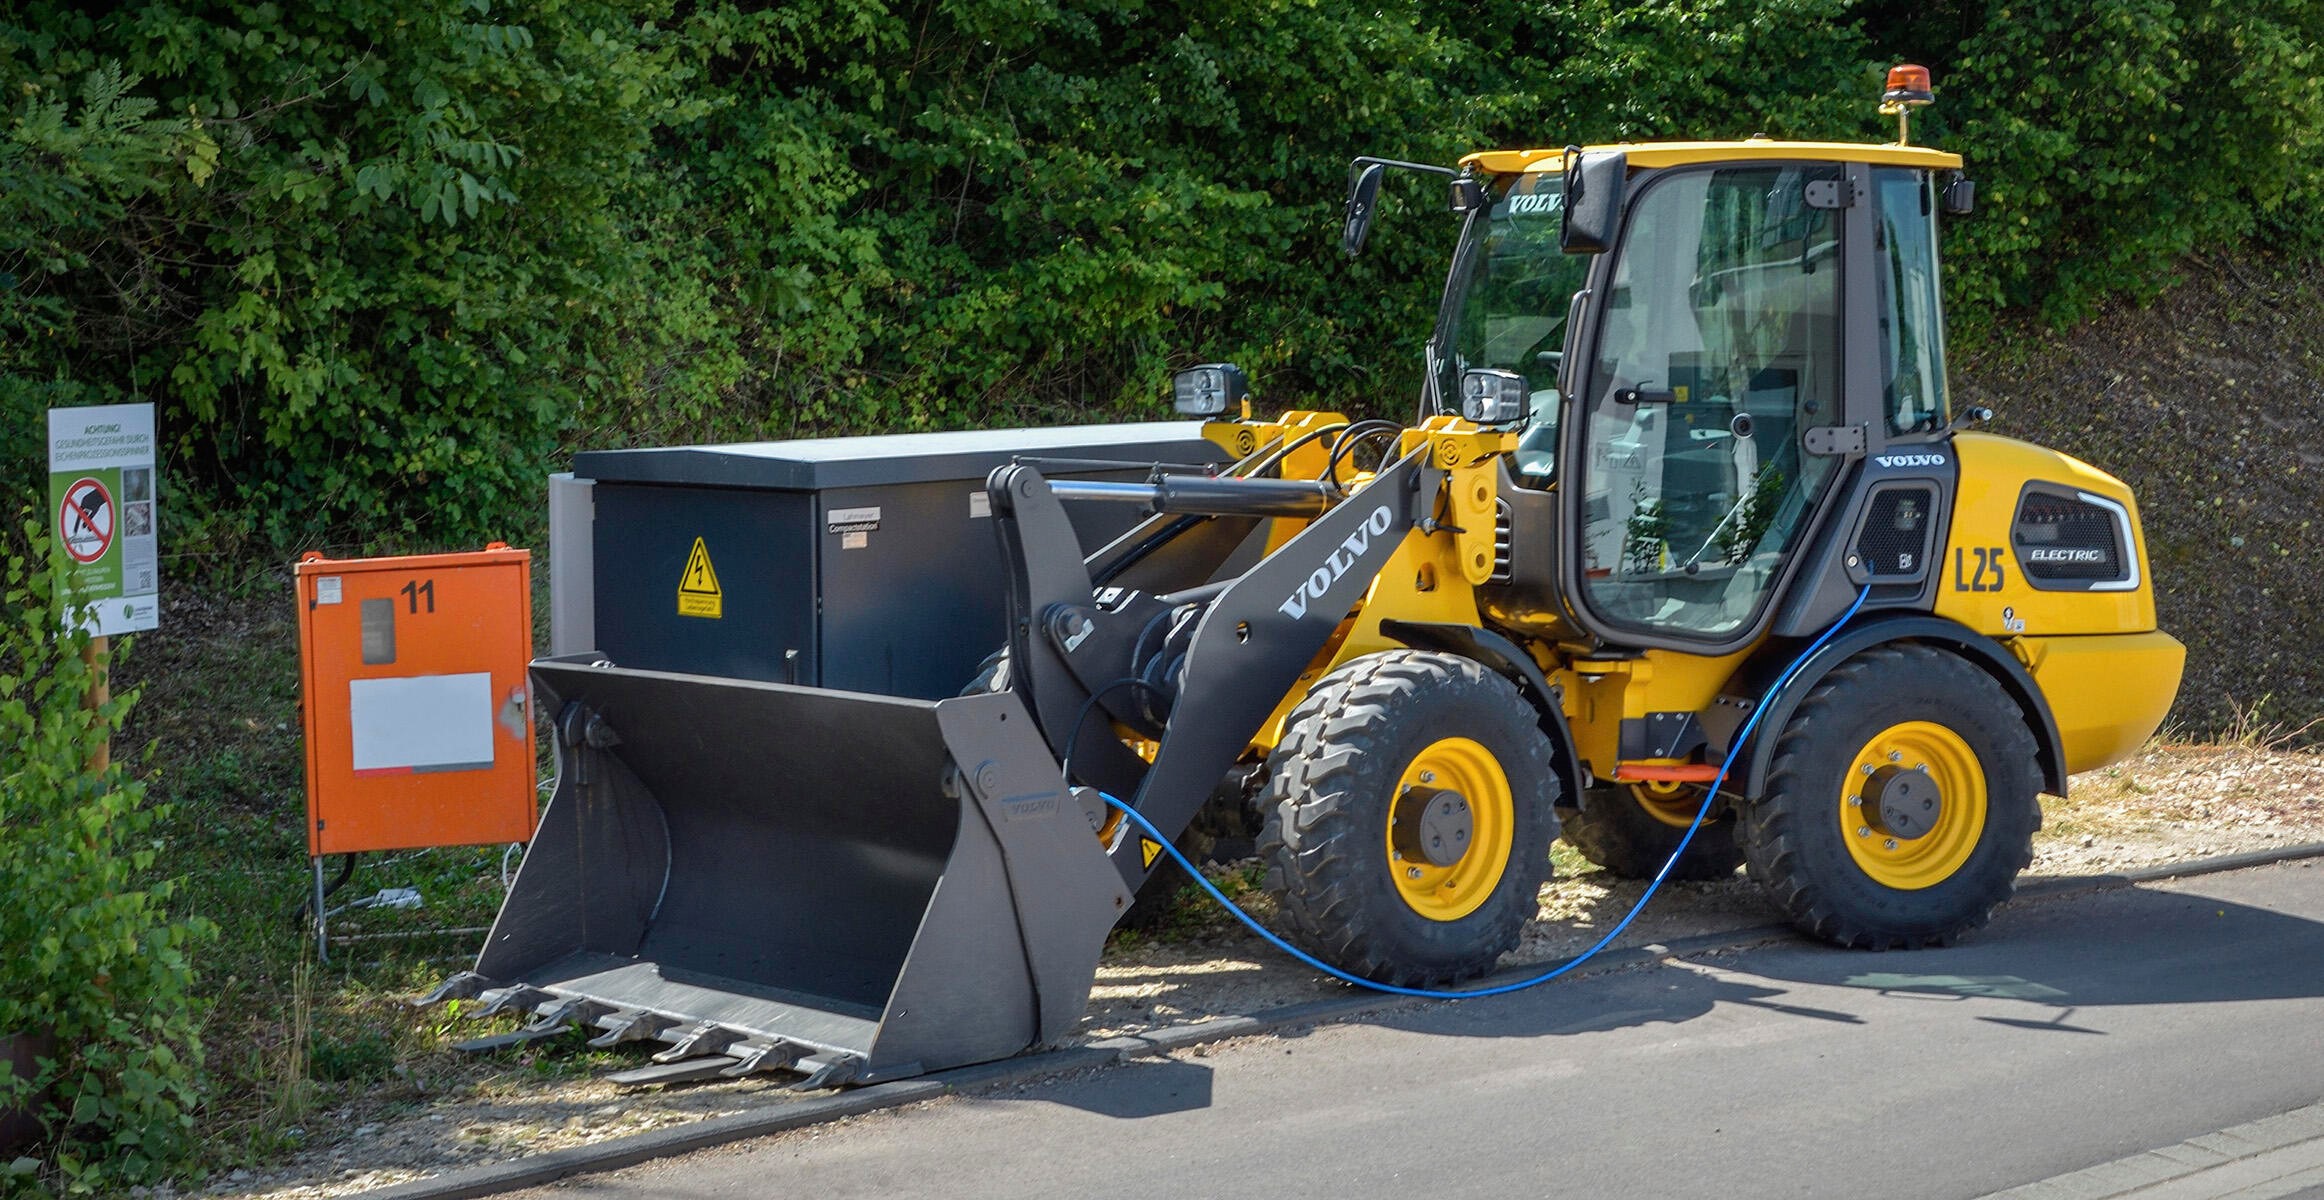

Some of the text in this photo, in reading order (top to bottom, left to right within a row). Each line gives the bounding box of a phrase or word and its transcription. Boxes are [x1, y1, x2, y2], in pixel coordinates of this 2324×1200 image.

[1875, 454, 1945, 468] VOLVO
[1278, 505, 1392, 620] VOLVO
[1955, 548, 2005, 592] L25
[2030, 550, 2099, 561] ELECTRIC
[400, 579, 434, 614] 11
